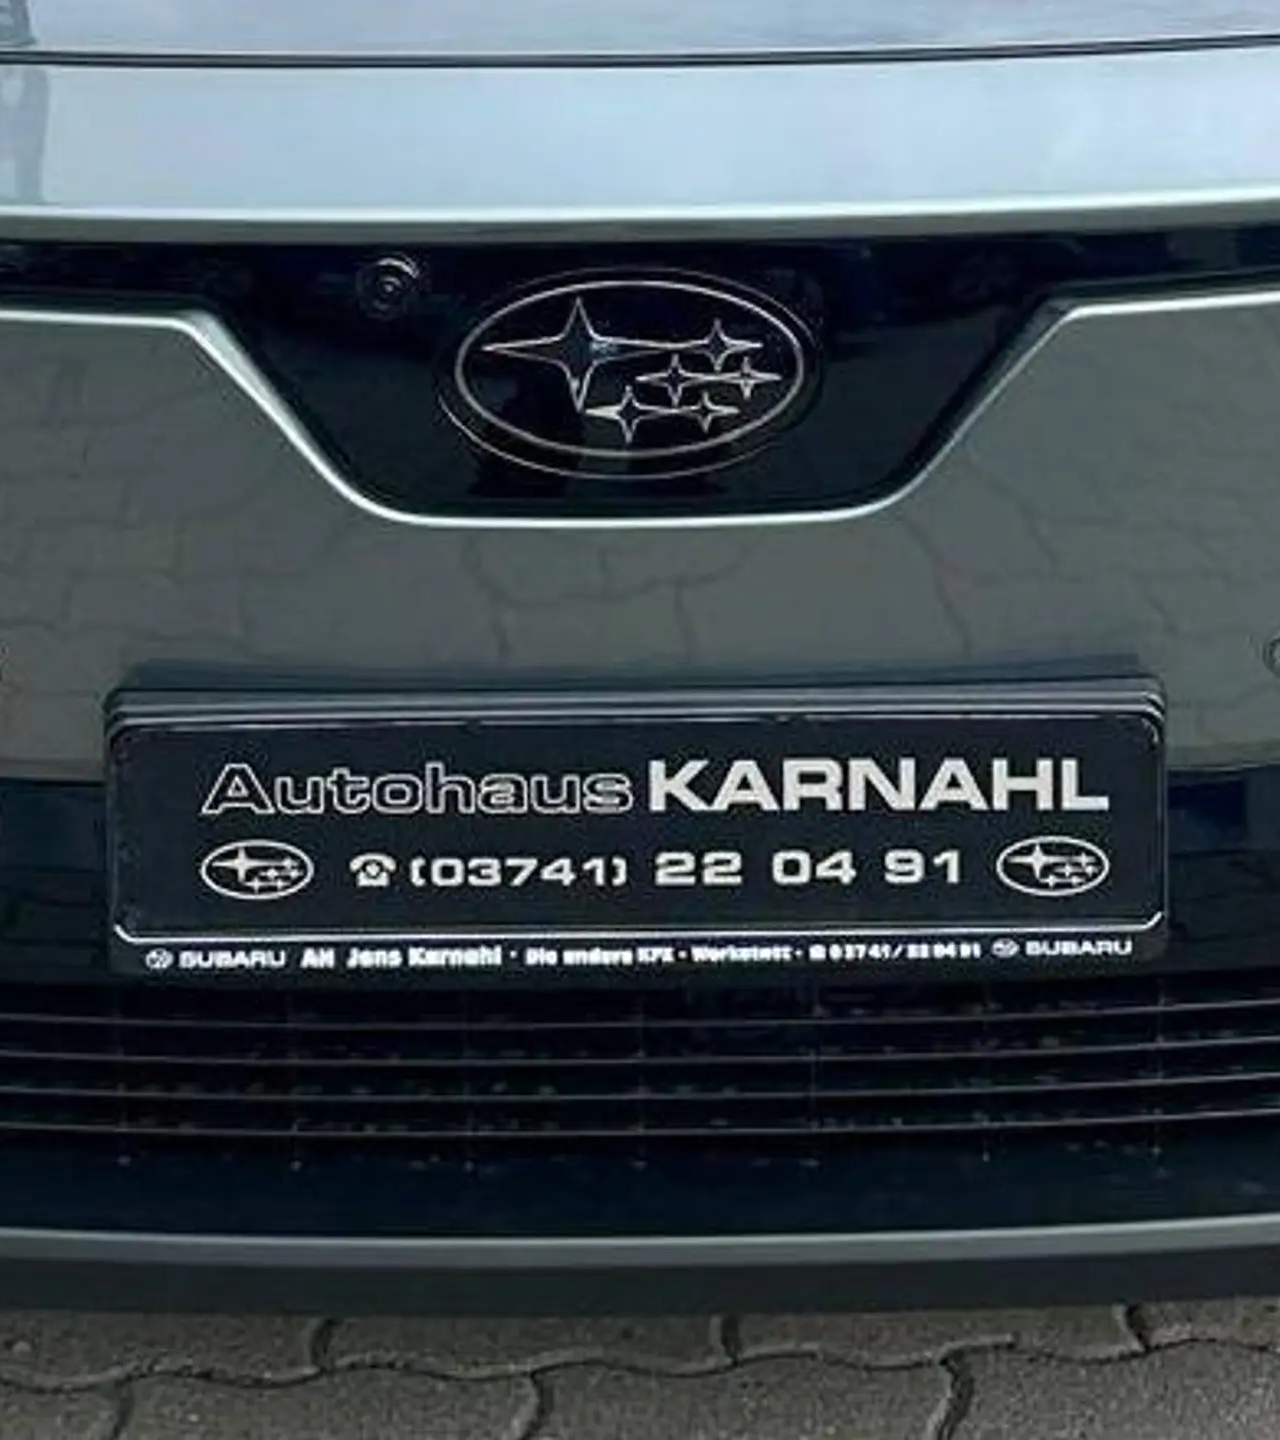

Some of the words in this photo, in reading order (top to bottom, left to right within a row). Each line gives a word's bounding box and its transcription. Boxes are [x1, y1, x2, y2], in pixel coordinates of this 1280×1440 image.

[200, 762, 635, 815] Autohaus
[647, 757, 1110, 812] KARNAHL
[409, 856, 628, 888] (03741)
[654, 851, 743, 886] 22
[772, 850, 857, 885] 04
[884, 849, 960, 884] 91
[179, 949, 287, 969] SUBARU
[346, 947, 403, 969] Jens
[407, 944, 503, 967] Karnahl
[1025, 939, 1133, 957] SUBARU
